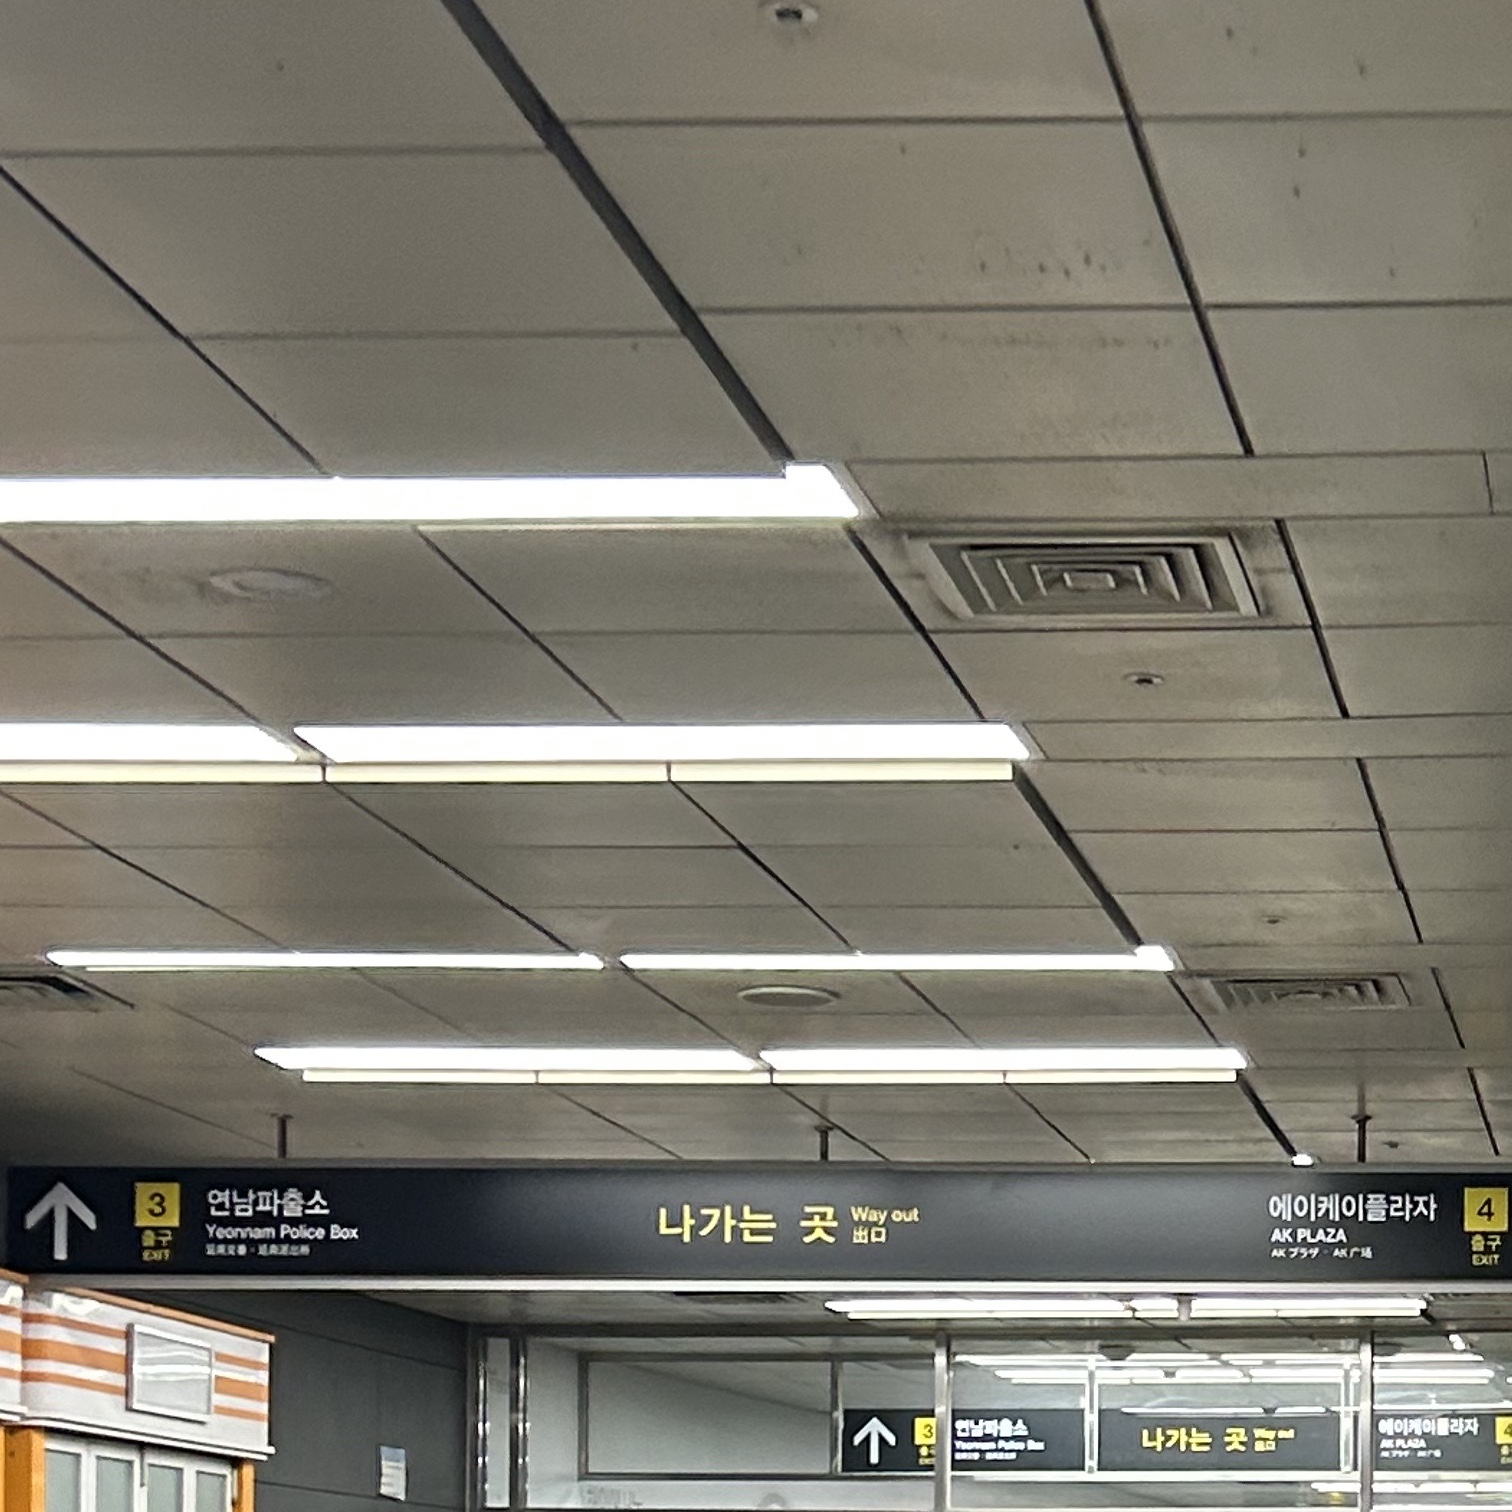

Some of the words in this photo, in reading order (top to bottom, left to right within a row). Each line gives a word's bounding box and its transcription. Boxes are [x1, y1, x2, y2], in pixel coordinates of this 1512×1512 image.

[149, 1193, 166, 1217] 3
[207, 1188, 330, 1217] 연남파출소
[1268, 1193, 1437, 1223] 에이케이플라자
[1476, 1198, 1494, 1221] 4
[658, 1204, 777, 1243] 나가는
[800, 1205, 839, 1243] 곳
[850, 1206, 887, 1225] Way
[891, 1207, 919, 1222] out
[205, 1224, 276, 1239] Yeonnam
[280, 1224, 325, 1239] Police
[330, 1225, 358, 1239] Box
[852, 1227, 886, 1244] 出口
[1270, 1228, 1292, 1244] AK
[1297, 1228, 1347, 1244] PLAZA
[1470, 1234, 1501, 1252] 출구
[1472, 1254, 1499, 1266] EXIT
[923, 1424, 934, 1438] 3
[1142, 1427, 1212, 1451] 나가는
[1223, 1427, 1248, 1451] 곳
